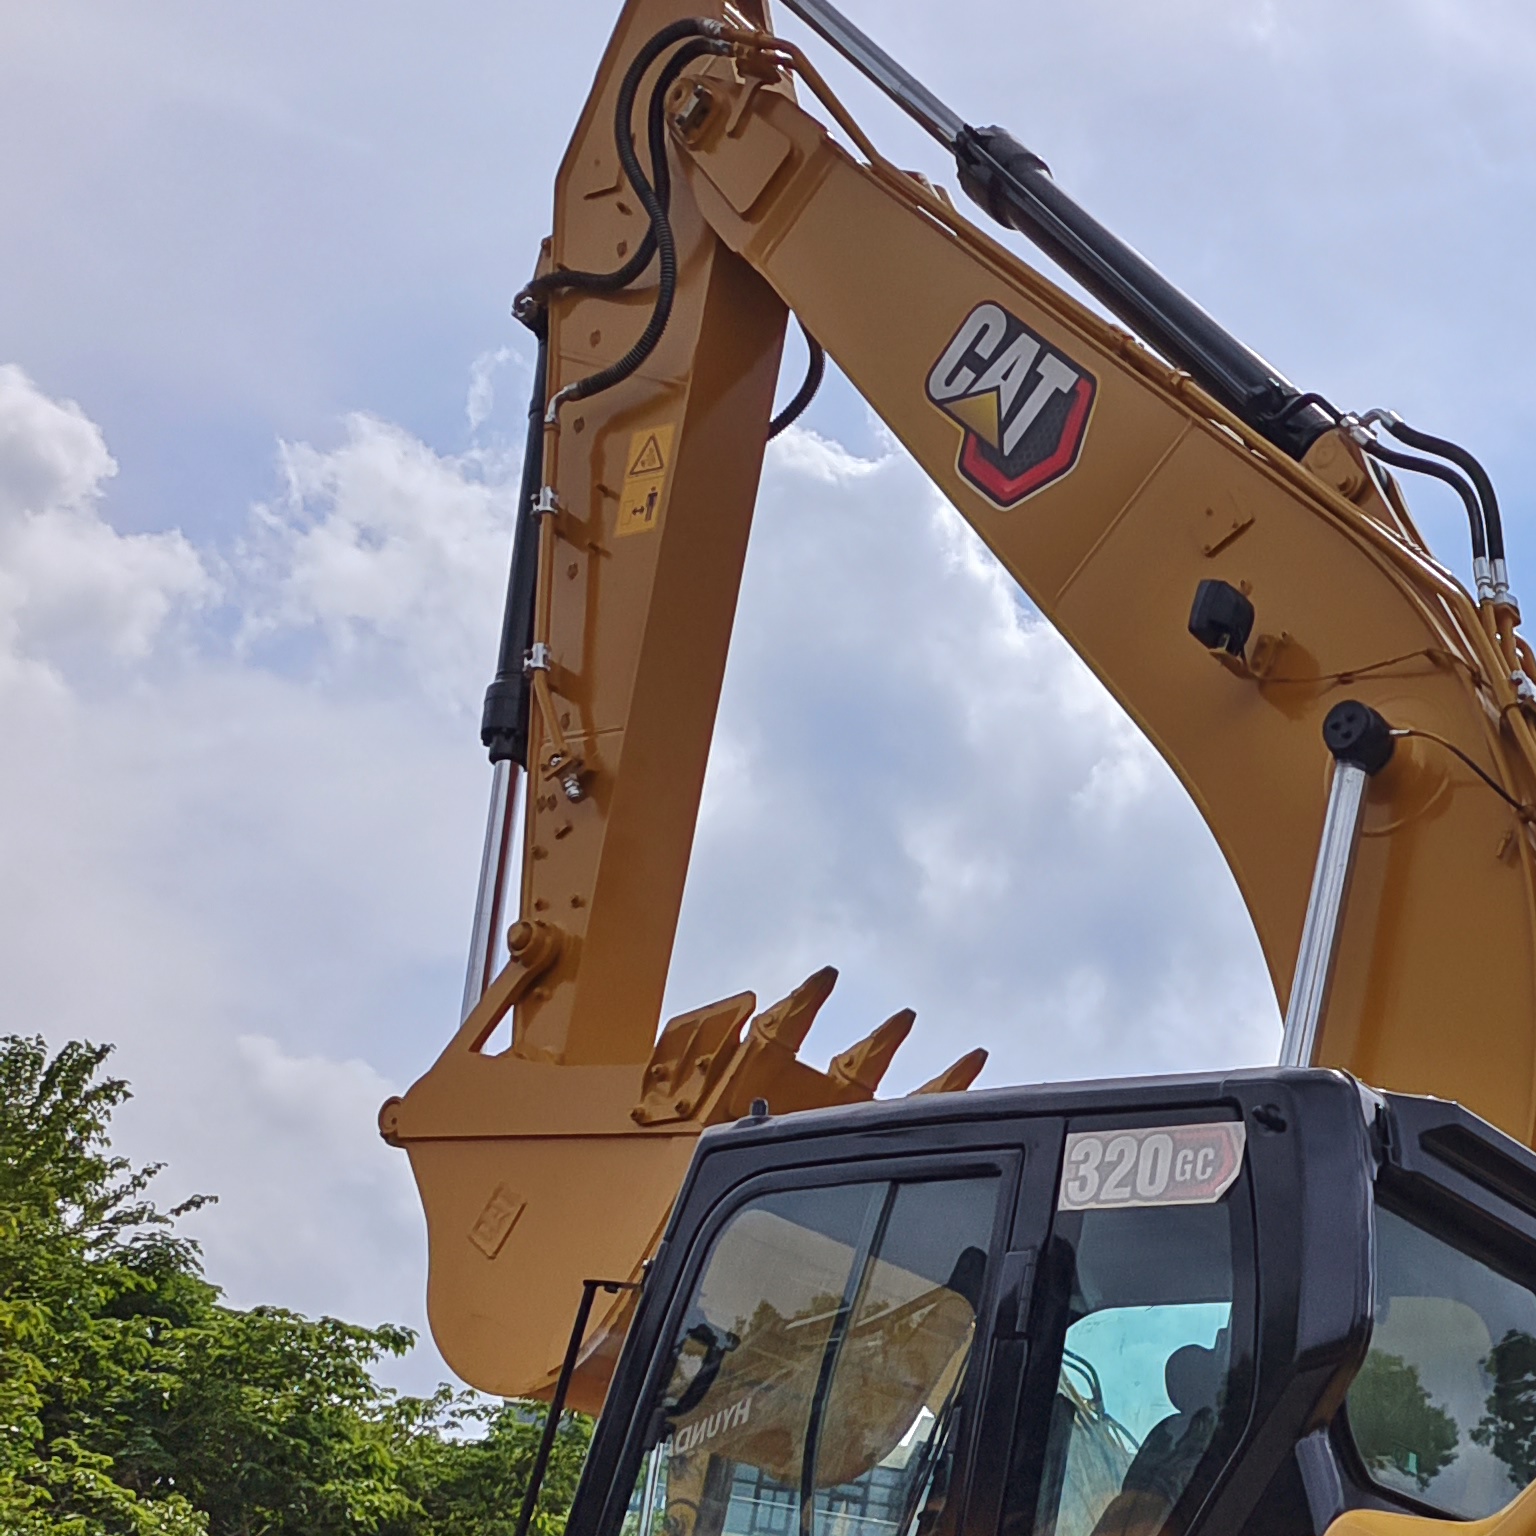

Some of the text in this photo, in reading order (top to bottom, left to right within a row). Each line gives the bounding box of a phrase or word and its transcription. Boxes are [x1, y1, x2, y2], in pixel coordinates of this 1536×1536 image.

[928, 303, 1080, 457] CAT
[1066, 1133, 1216, 1201] 320 GC
